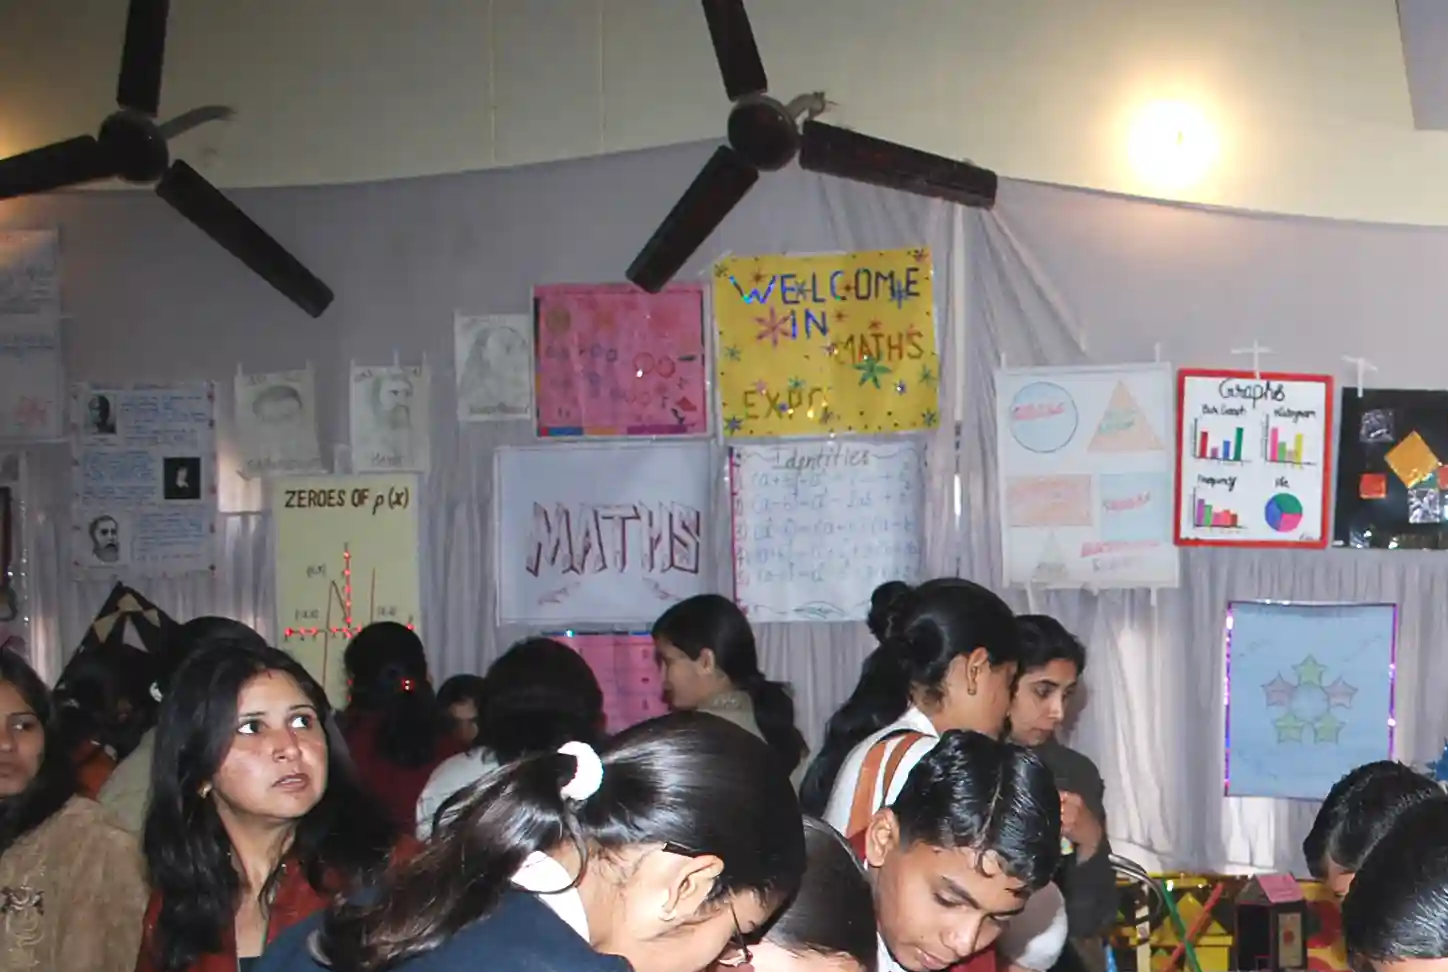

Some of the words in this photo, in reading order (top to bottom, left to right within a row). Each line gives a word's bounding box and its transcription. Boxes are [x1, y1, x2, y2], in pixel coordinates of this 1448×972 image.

[729, 266, 920, 304] WELCOME
[791, 307, 829, 339] IN
[834, 329, 924, 364] MATHS
[1218, 376, 1286, 409] Graphs
[772, 444, 870, 470] Identities
[284, 489, 347, 509] ZEROES
[351, 488, 370, 508] OF
[525, 500, 701, 578] MATHS
